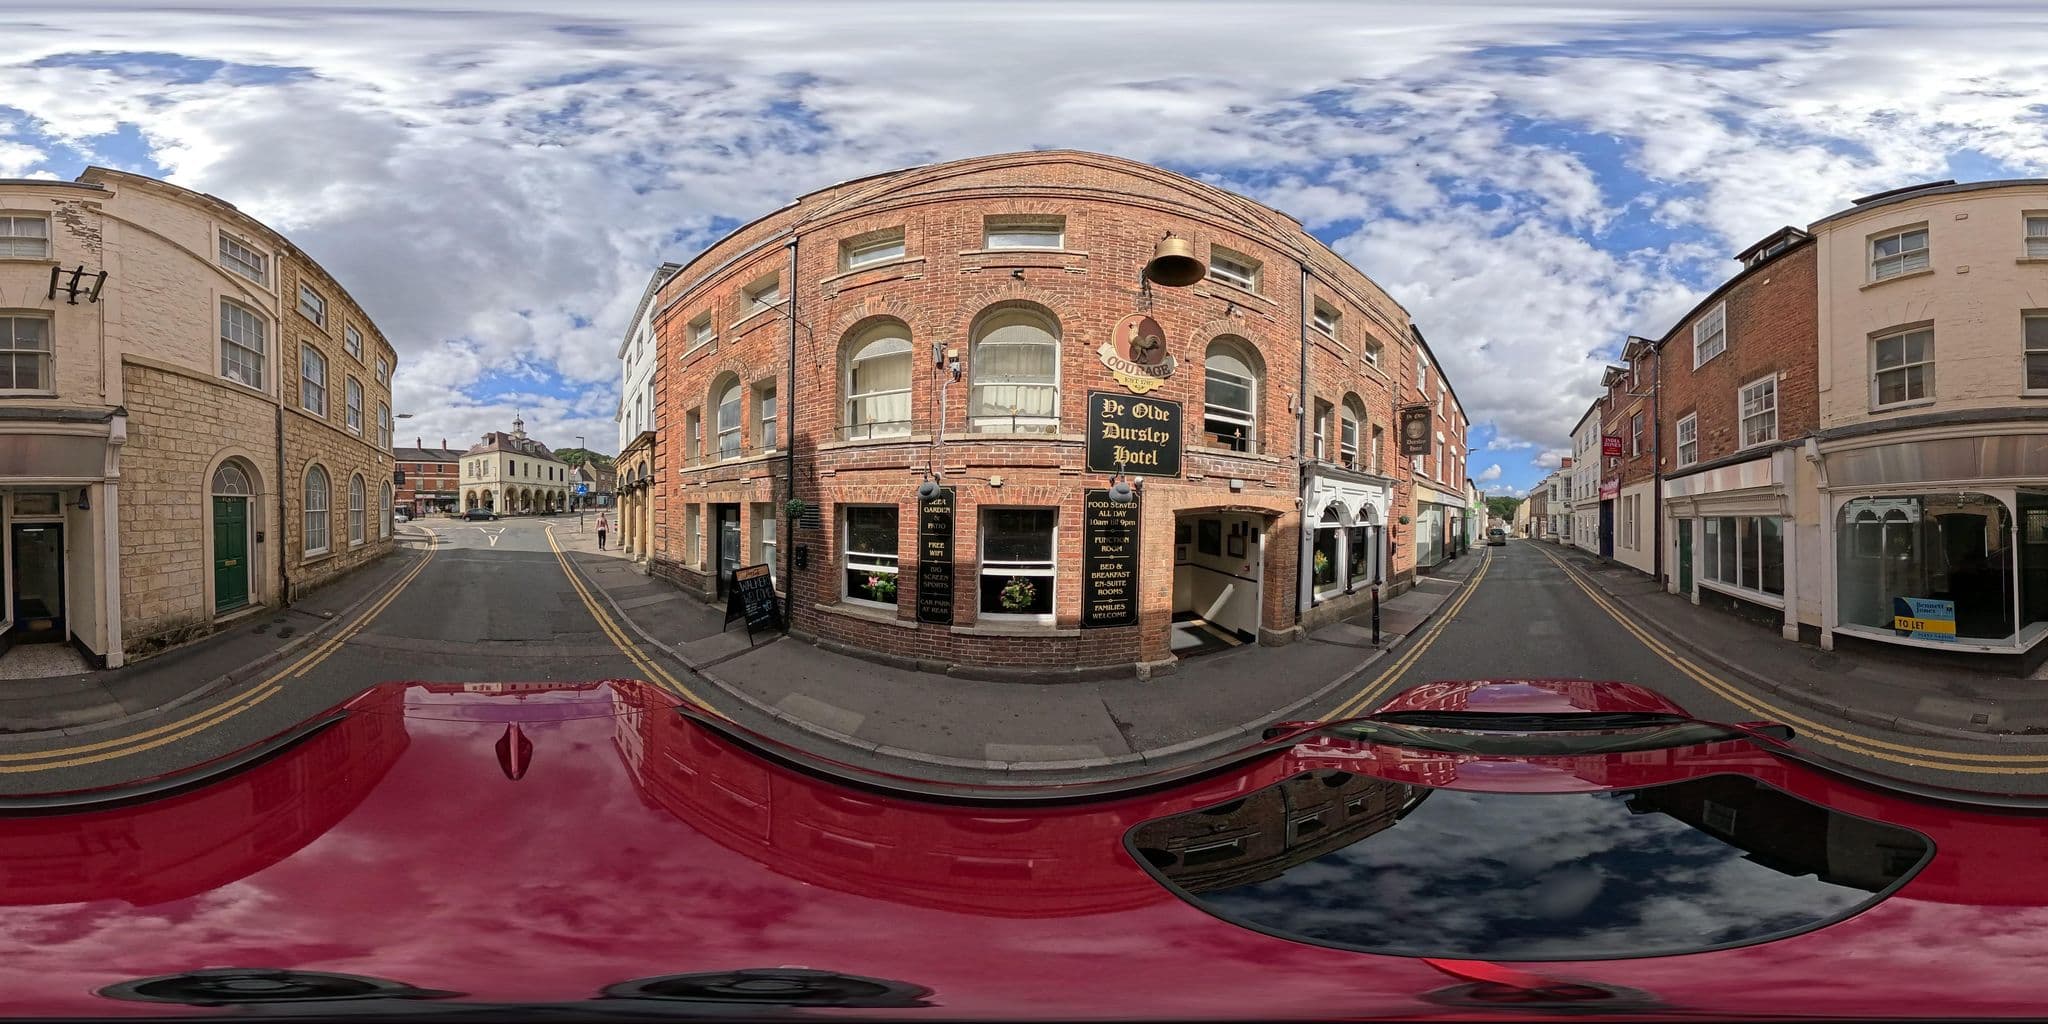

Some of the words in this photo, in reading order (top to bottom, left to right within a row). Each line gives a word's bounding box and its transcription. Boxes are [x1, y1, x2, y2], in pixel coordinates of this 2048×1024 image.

[1108, 356, 1170, 377] COURAGE
[1102, 398, 1125, 418] Ye
[1132, 402, 1170, 422] Olde
[1102, 422, 1169, 447] Dursley
[1113, 445, 1158, 466] Hotel
[1898, 619, 1908, 628] TO
[1912, 621, 1924, 630] LET
